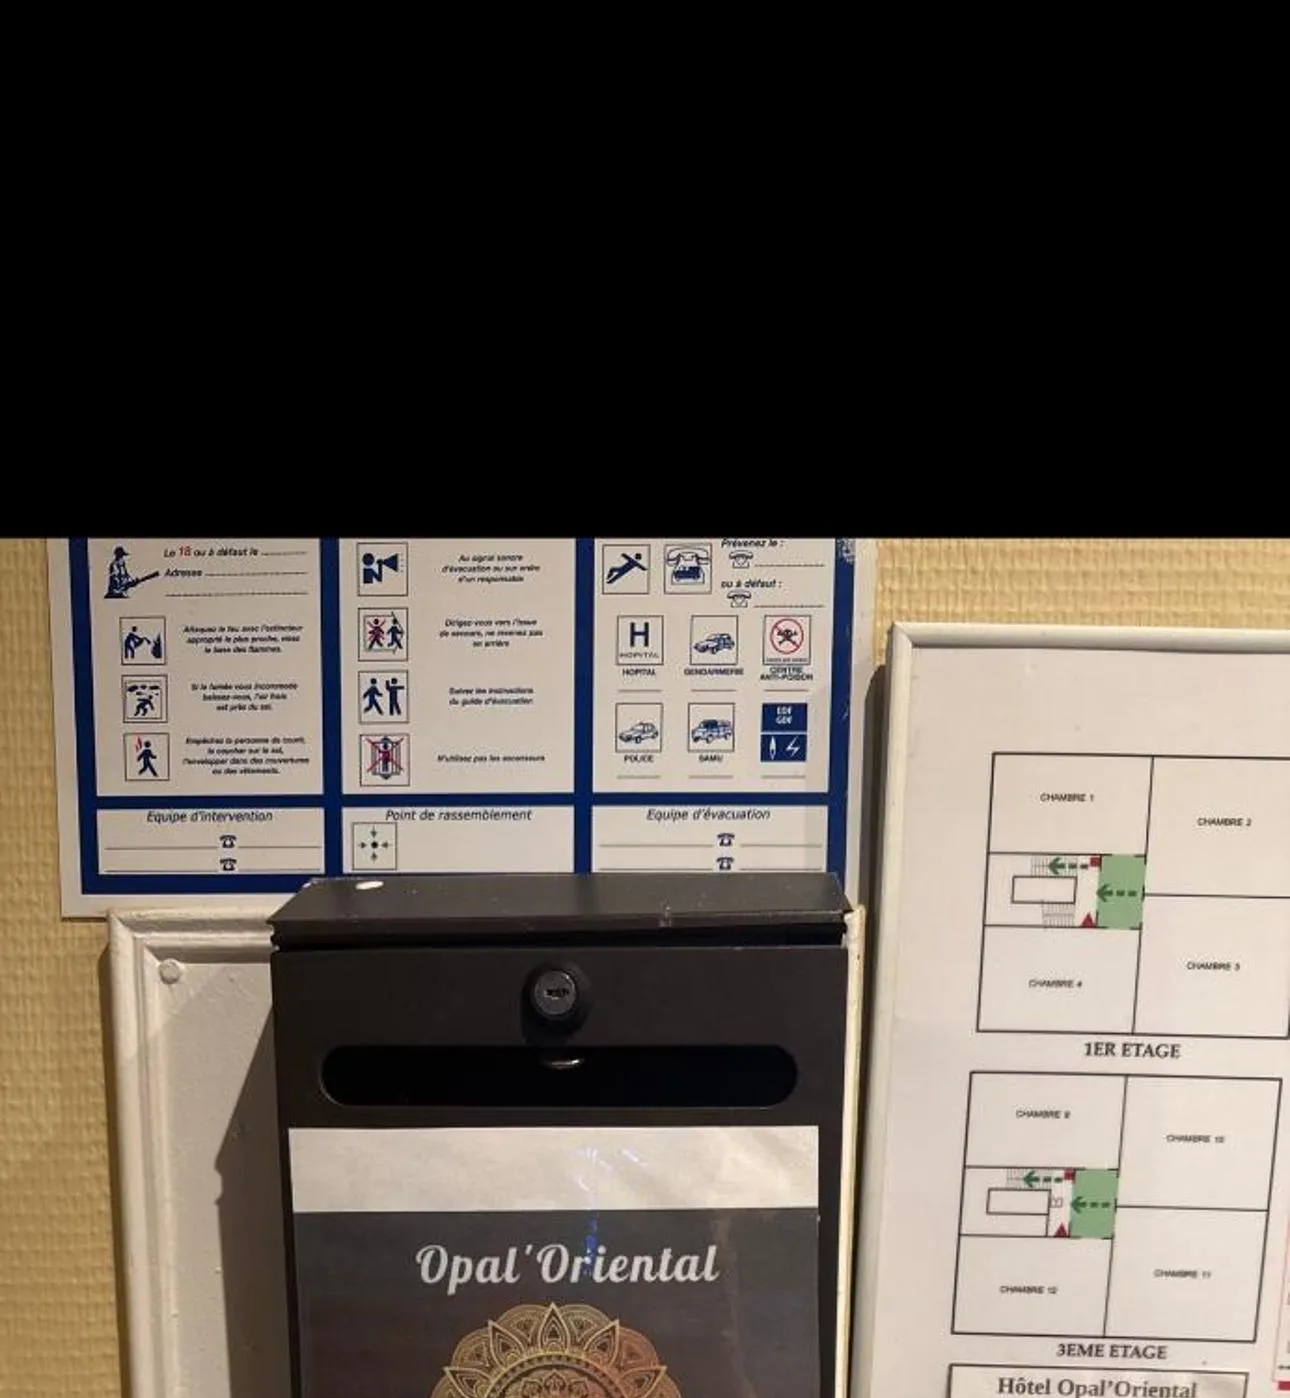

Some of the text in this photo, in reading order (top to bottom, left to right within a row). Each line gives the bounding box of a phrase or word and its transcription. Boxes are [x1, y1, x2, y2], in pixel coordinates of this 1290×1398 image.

[624, 754, 654, 763] POLICE
[699, 754, 723, 763] SAMU
[1040, 793, 1087, 803] CHAMBRE
[147, 810, 273, 825] Equipe d'intervention
[385, 808, 533, 822] Point de rassemblement
[646, 808, 771, 823] Equipe d'évacuation
[1197, 817, 1243, 827] CHAMBRE
[1187, 961, 1231, 971] CHAMBRE
[1028, 979, 1074, 989] CHAMBRE
[1084, 1041, 1181, 1059] 1ER ETAGE
[1015, 1110, 1061, 1119] CHAMBRE
[1166, 1134, 1211, 1143] CHAMBRE
[1153, 1269, 1198, 1278] CHAMBRE
[999, 1285, 1044, 1294] CHAMBRE
[1056, 1343, 1168, 1360] 3EME ETAGE
[998, 1377, 1050, 1395] Hôtel
